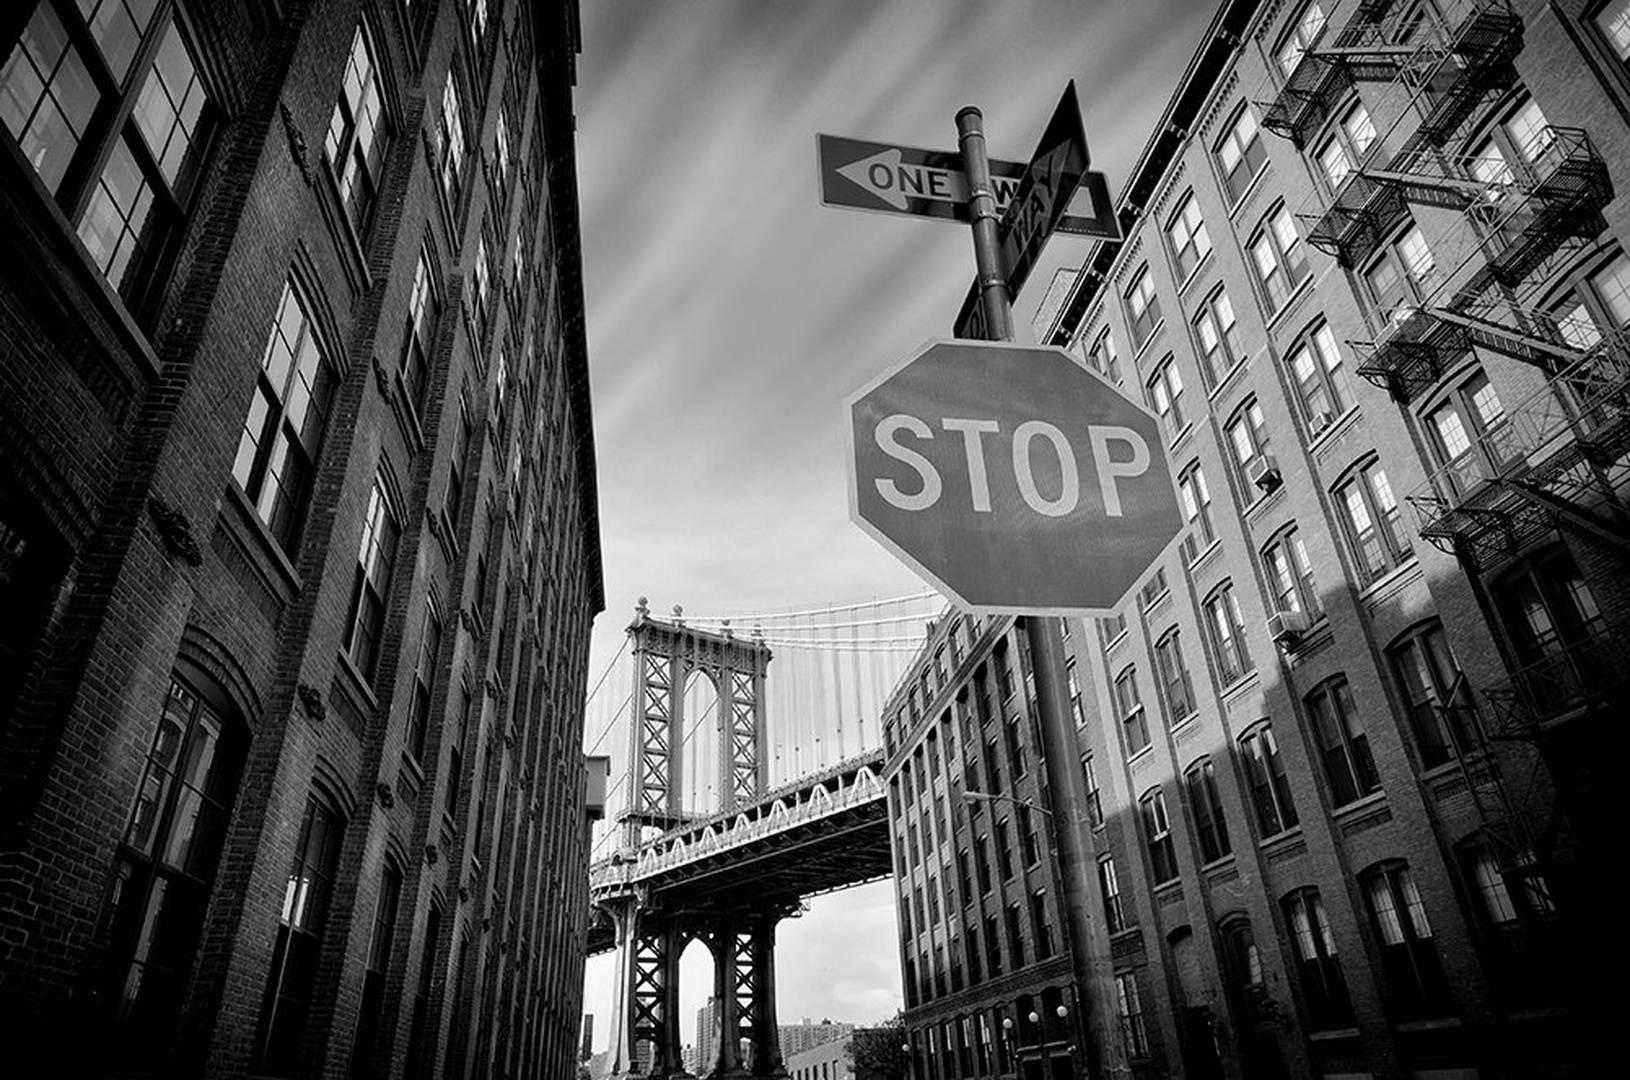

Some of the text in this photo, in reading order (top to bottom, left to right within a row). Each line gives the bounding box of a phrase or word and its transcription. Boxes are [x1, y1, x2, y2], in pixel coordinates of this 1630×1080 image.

[868, 162, 952, 198] ONE
[1013, 155, 1053, 254] WAY
[874, 413, 1151, 518] STOP
